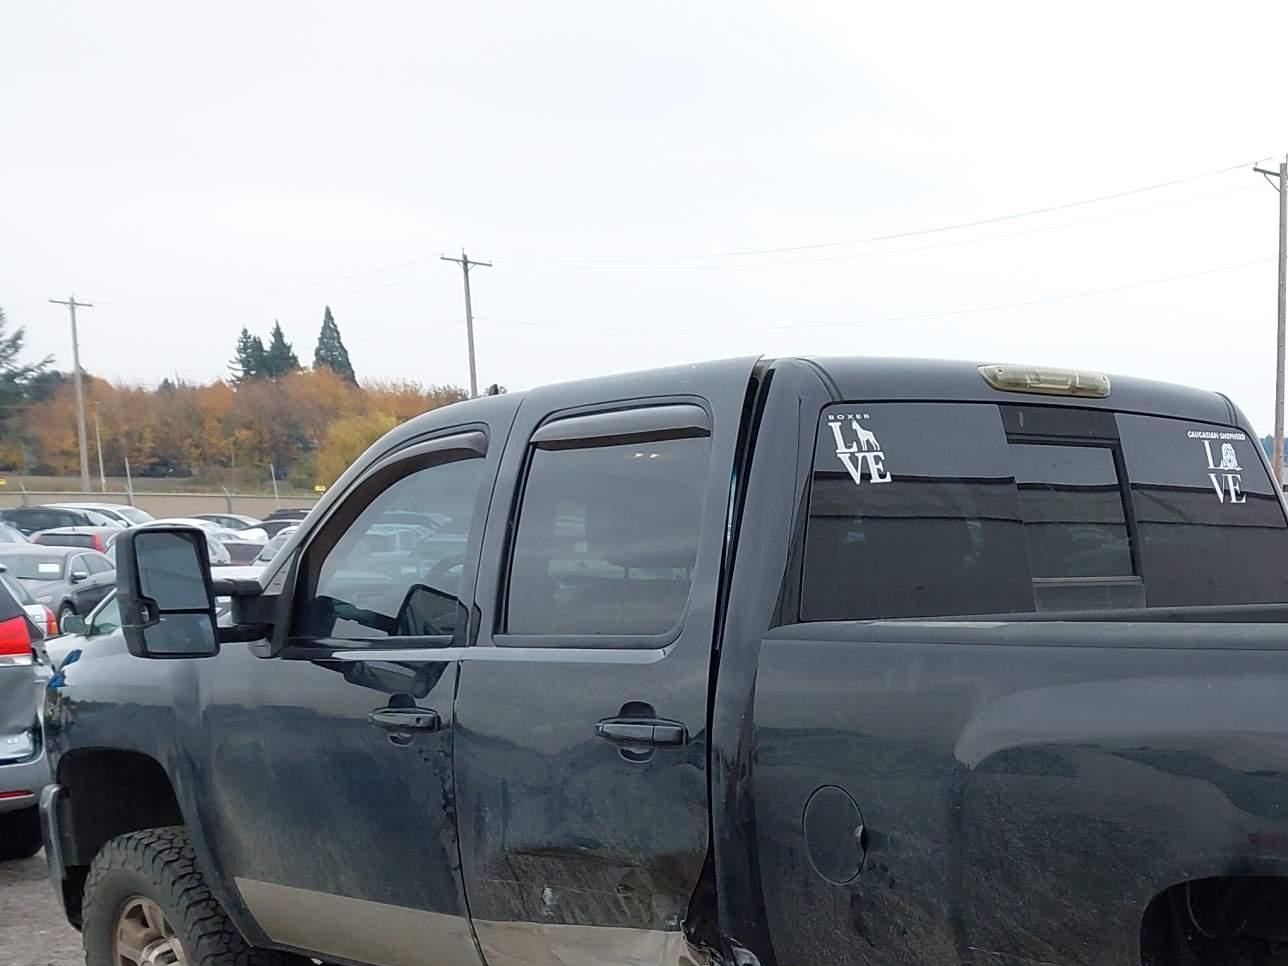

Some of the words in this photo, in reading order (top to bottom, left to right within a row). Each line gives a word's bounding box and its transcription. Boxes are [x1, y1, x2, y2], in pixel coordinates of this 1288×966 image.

[828, 413, 870, 421] BOXER
[1187, 430, 1219, 439] CAUCASIAN
[1219, 432, 1246, 441] SHEPHERD
